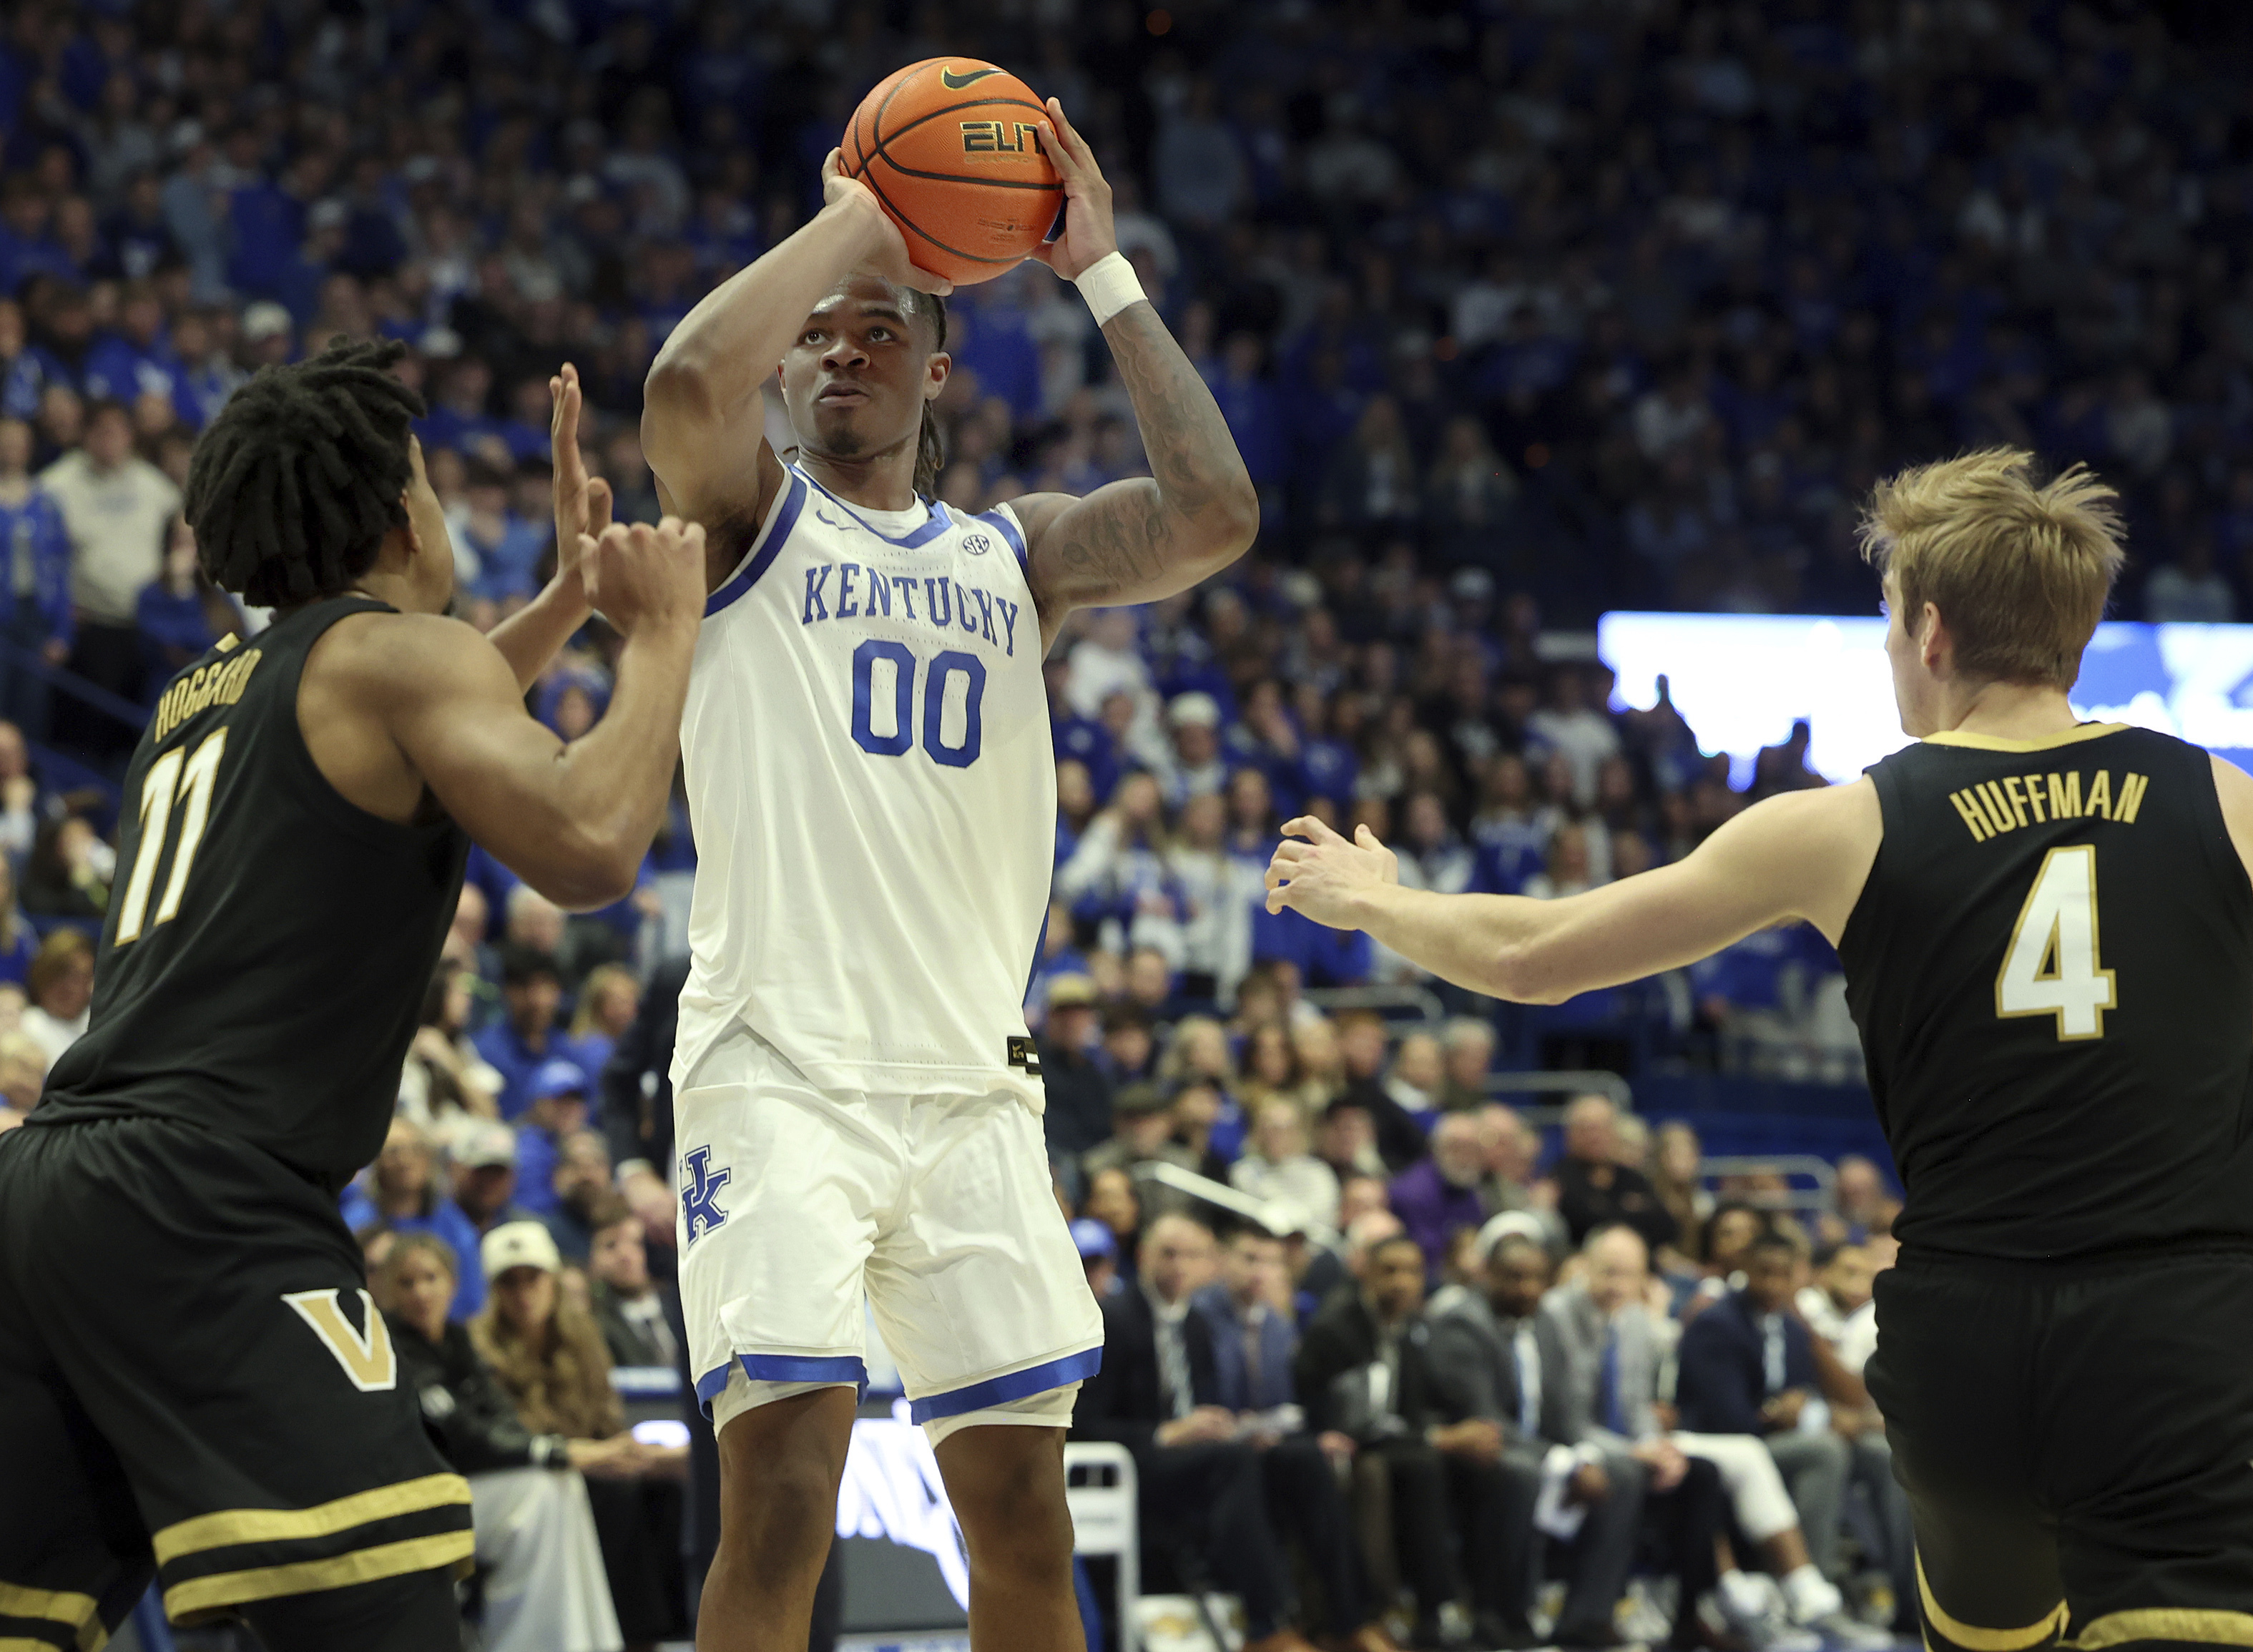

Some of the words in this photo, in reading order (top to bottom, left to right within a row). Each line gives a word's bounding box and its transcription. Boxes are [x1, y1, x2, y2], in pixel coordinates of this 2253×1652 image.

[960, 120, 1047, 155] ELIT
[962, 534, 990, 556] SEC
[802, 563, 1018, 657] KENTUCKY
[851, 639, 986, 768] 00
[114, 725, 229, 948] 11
[1949, 770, 2149, 843] HUFFMAN
[1994, 843, 2118, 1042] 4
[280, 1287, 397, 1392] V
